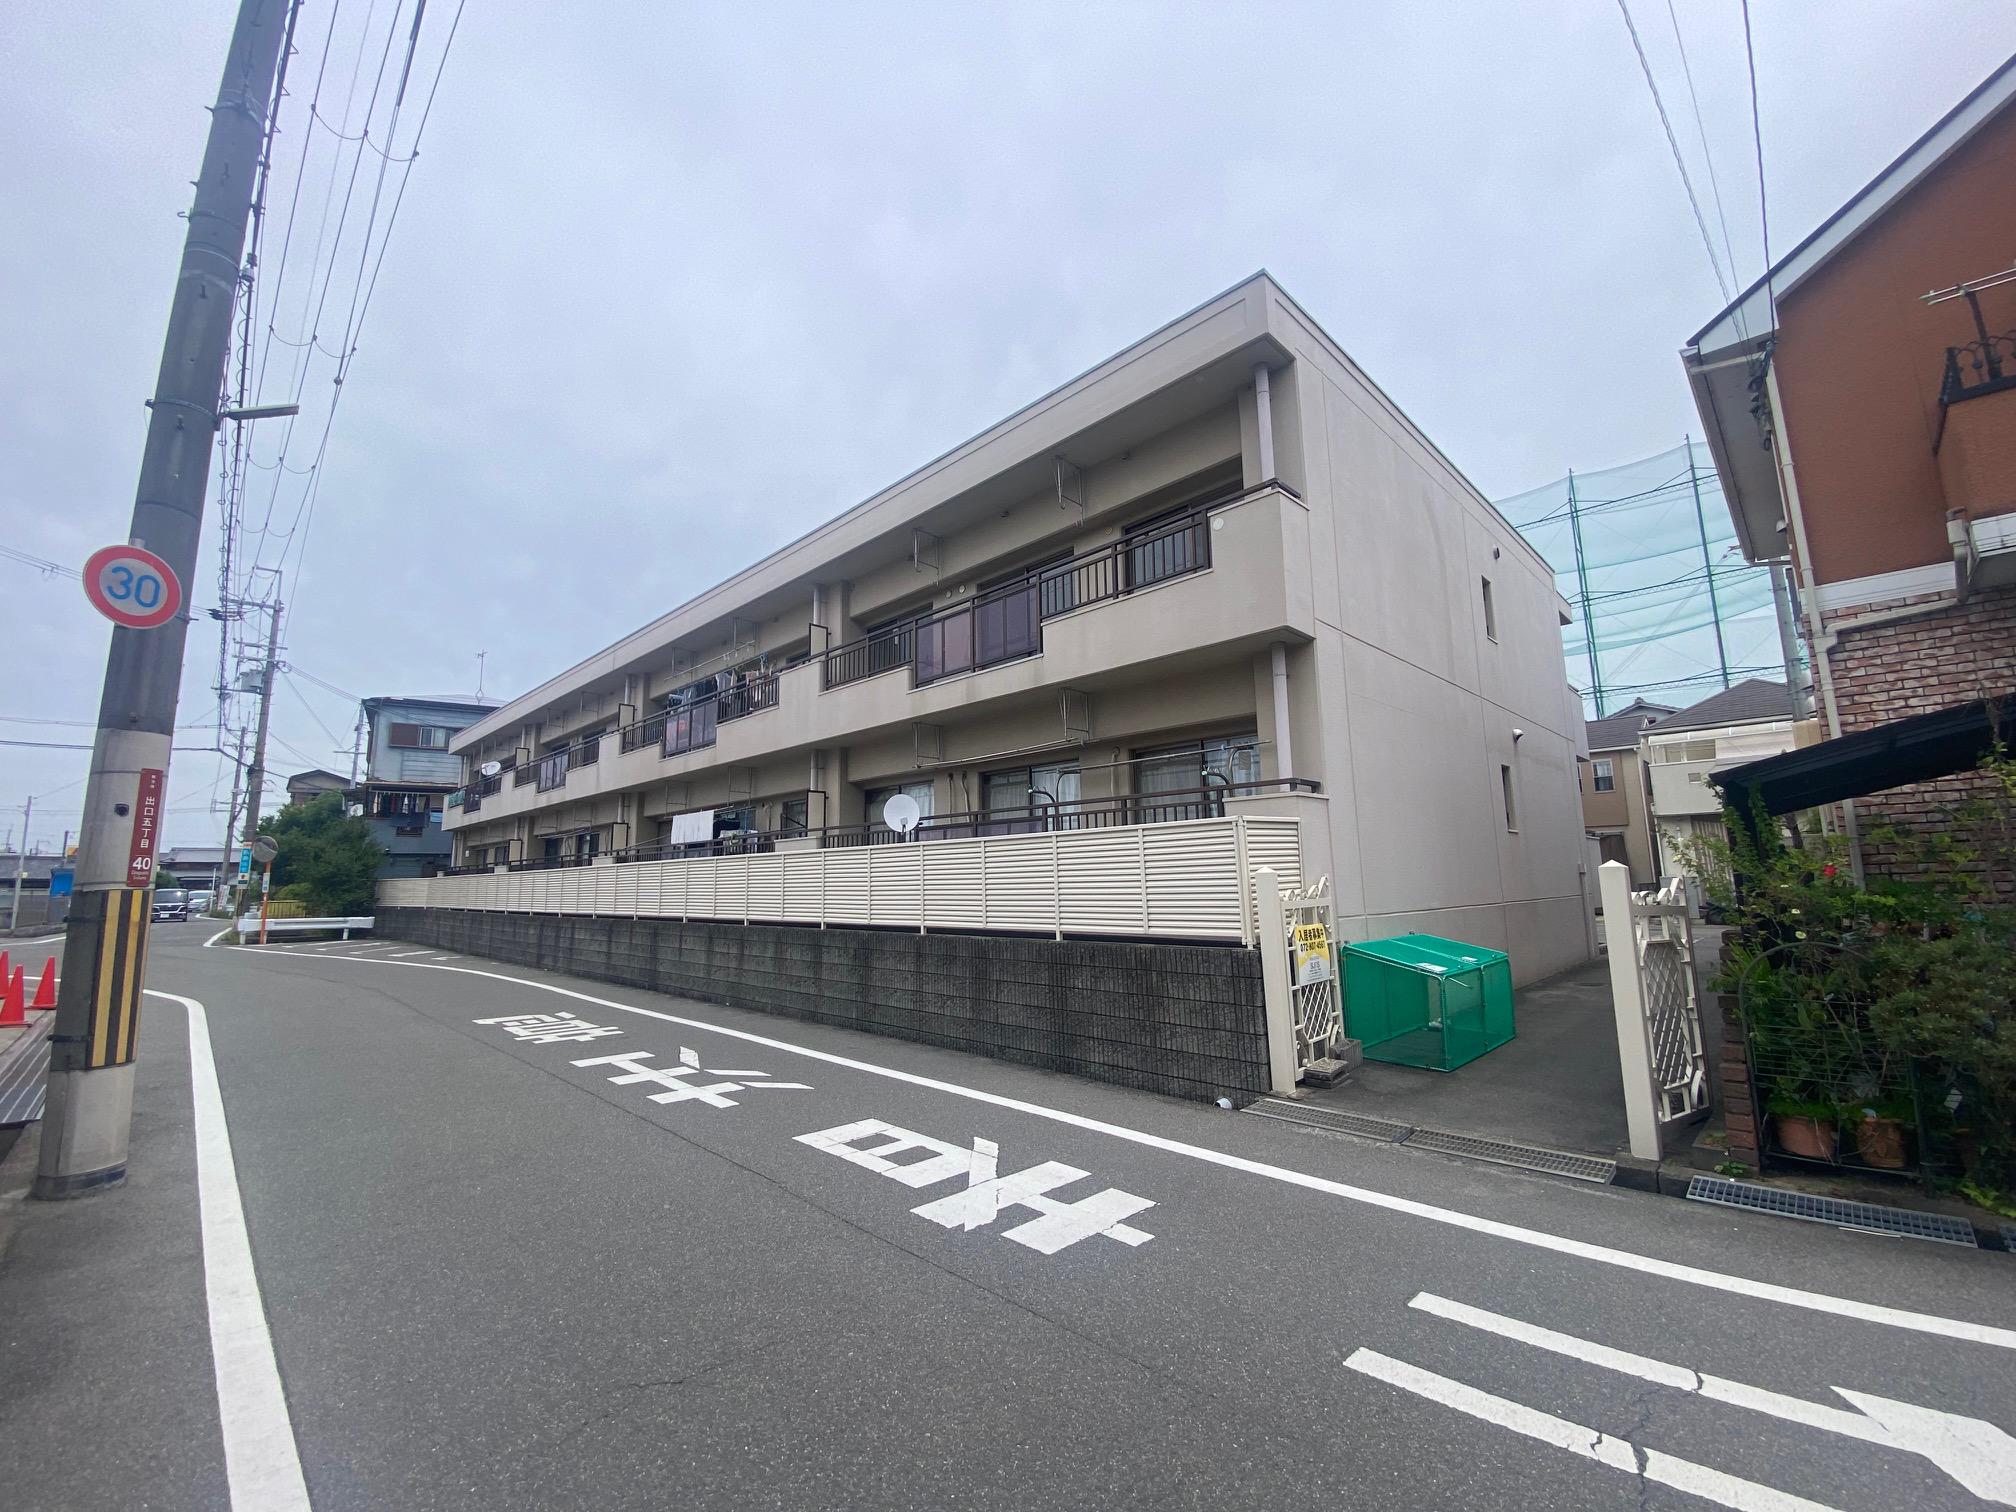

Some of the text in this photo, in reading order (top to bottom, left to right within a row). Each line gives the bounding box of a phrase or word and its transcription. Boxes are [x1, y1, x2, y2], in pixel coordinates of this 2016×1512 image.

[107, 566, 161, 608] 30
[140, 796, 156, 849] 出口五丁目
[132, 856, 152, 871] 40
